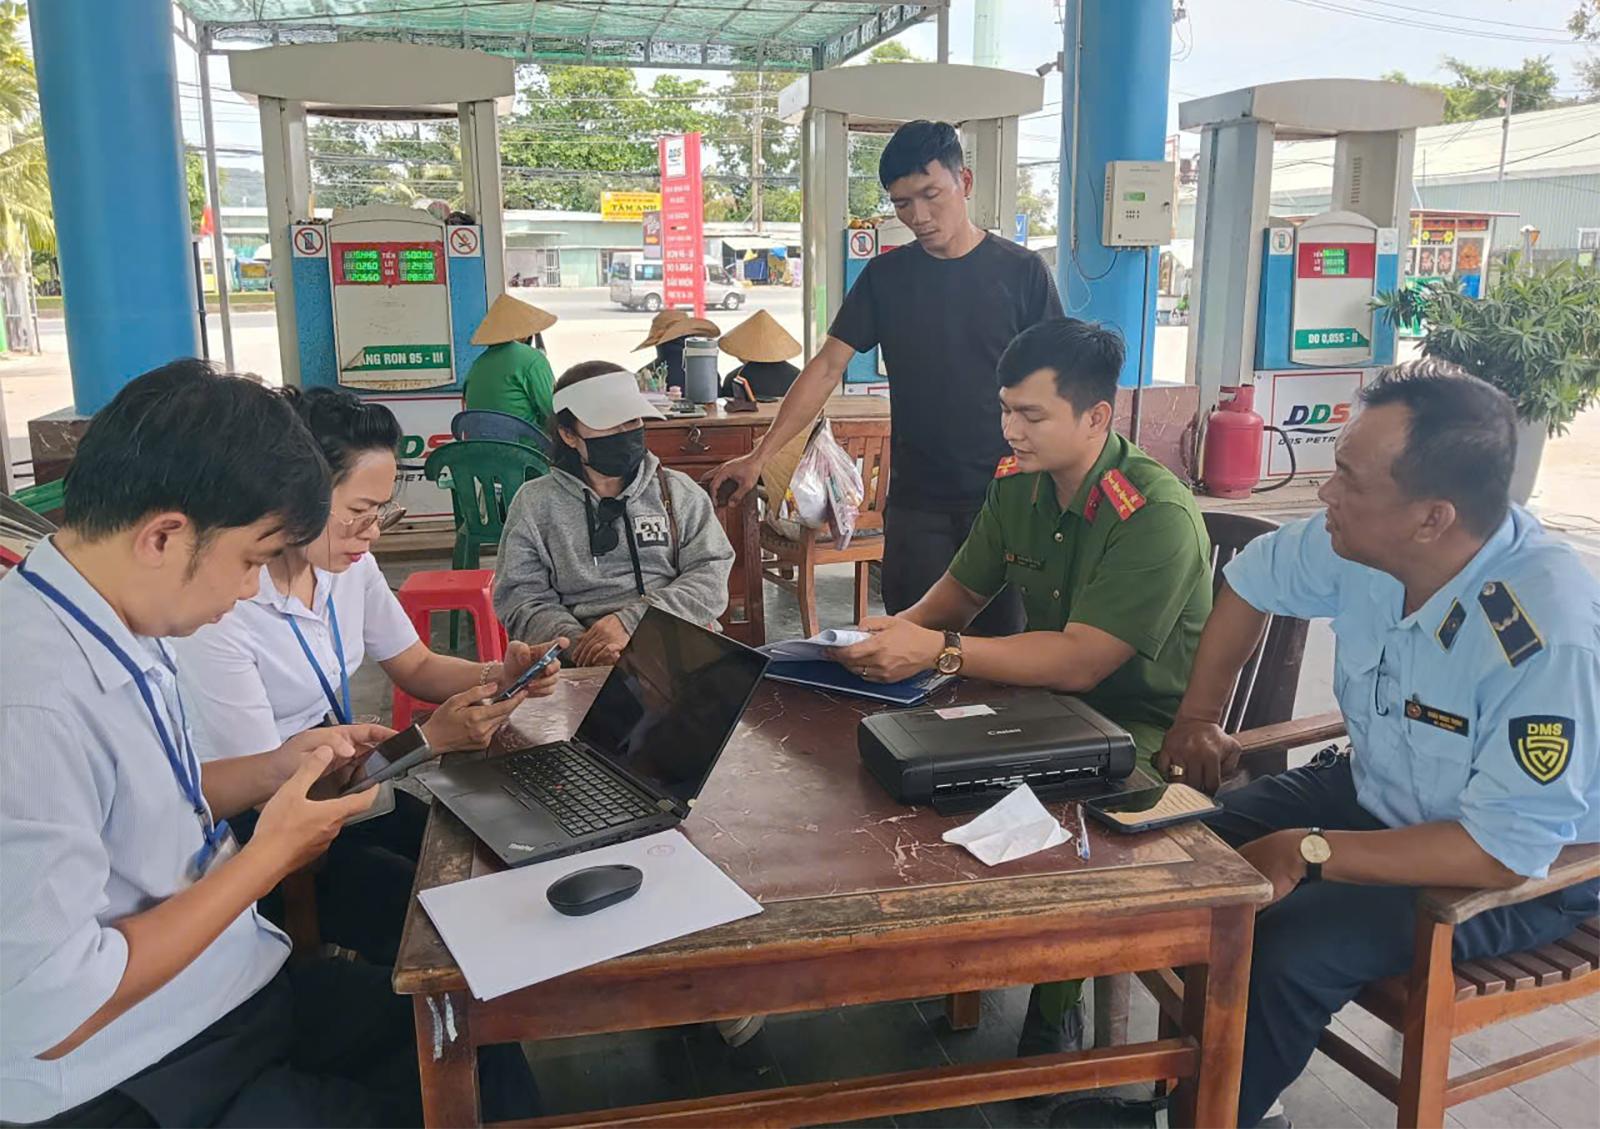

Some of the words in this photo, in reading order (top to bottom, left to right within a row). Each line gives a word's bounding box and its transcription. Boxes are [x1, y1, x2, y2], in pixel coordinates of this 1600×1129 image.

[384, 353, 407, 364] RON
[409, 353, 422, 364] 95
[432, 352, 444, 363] III
[1283, 403, 1352, 425] DDS
[1528, 723, 1562, 735] DMS
